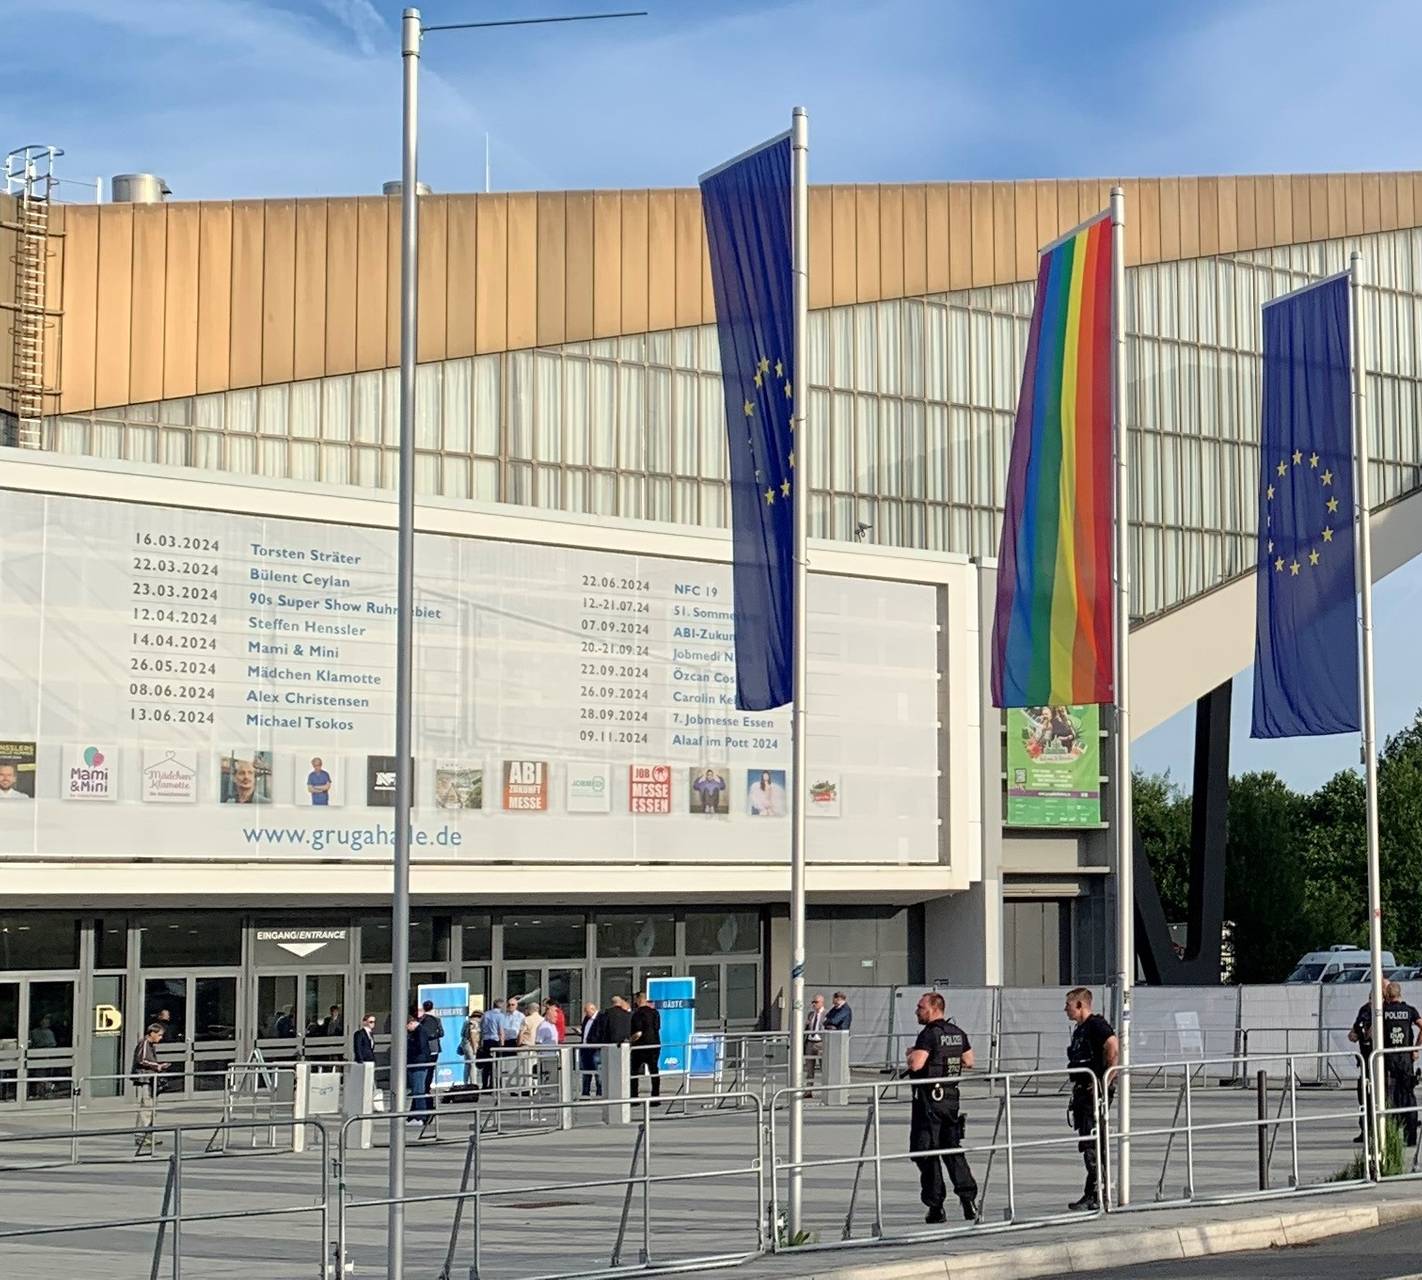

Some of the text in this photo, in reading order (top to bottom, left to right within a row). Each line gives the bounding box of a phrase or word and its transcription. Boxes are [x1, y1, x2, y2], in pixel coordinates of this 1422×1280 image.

[136, 532, 219, 551] 16.03.2024
[250, 543, 361, 565] Torsten Sträter
[133, 557, 218, 576] 22.03.2024
[250, 568, 350, 588] Bülent Ceylan
[582, 574, 649, 592] 22.06.2024
[133, 582, 217, 601] 23.03.2024
[674, 583, 718, 597] NFC 19
[249, 592, 272, 605] 90s
[277, 595, 320, 610] Super
[324, 598, 362, 612] Show
[583, 597, 649, 613] 12.-21.07.24
[134, 607, 217, 625] 12.04.2024
[673, 605, 690, 617] 51.
[249, 616, 366, 636] Steffen Henssler
[581, 619, 649, 635] 07.09.2024
[133, 632, 216, 650] 14.04.2024
[581, 641, 649, 657] 20.-21.09.24
[248, 641, 339, 659] Mami & Mini
[673, 647, 720, 663] Jobmedi
[131, 658, 216, 675] 26.05.2024
[581, 663, 648, 678] 22.09.2024
[673, 667, 710, 682] Özcan
[247, 665, 381, 685] Mädchen Klamotte
[129, 683, 215, 699] 08.06.2024
[246, 690, 369, 708] Alex Christensen
[580, 686, 648, 700] 26.09.2024
[673, 691, 715, 704] Carolin
[131, 707, 214, 724] 13.06.2024
[246, 714, 354, 731] Michael Tsokos
[580, 708, 648, 722] 28.09.2024
[673, 713, 774, 728] 7. Jobmesse Essen
[580, 730, 648, 743] 09.11.2024
[672, 734, 778, 749] Alaaf im Pott 2024
[71, 768, 108, 780] Mami
[509, 761, 542, 784] ABI
[635, 768, 650, 778] JOB
[509, 784, 541, 794] ZUKUNFT
[632, 783, 669, 797] MESSE
[509, 796, 541, 809] MESSE
[632, 798, 668, 812] ESSEN
[243, 823, 462, 850] www.grugahale.de
[256, 930, 346, 940] EINGANG/ENTRANCE
[1384, 1011, 1409, 1020] POLIZEI
